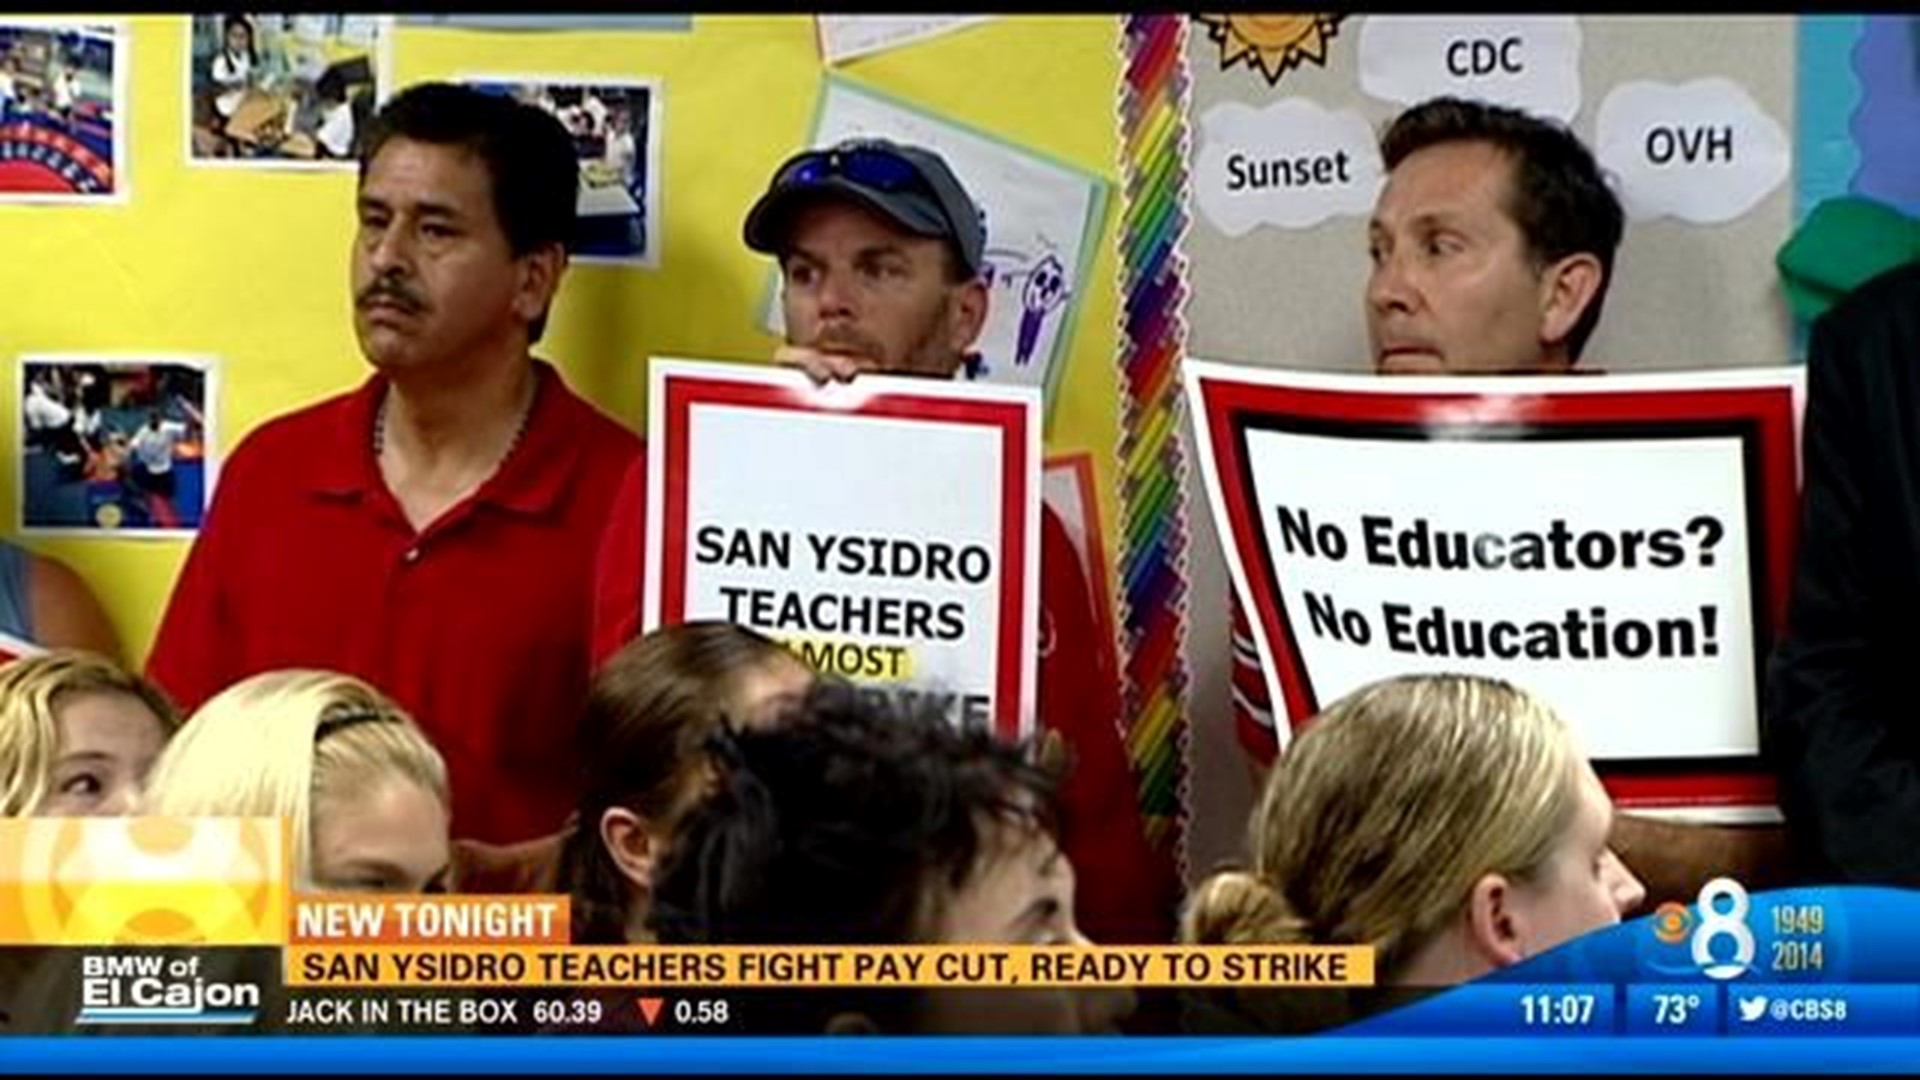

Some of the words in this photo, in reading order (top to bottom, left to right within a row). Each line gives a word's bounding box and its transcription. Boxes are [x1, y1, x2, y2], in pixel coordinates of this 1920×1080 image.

[1446, 37, 1524, 77] CDC
[1645, 126, 1733, 165] OVH
[1225, 149, 1350, 191] Sunset
[695, 526, 791, 570] SAN
[806, 533, 992, 584] YSIDRO
[1276, 505, 1347, 561] No
[1361, 515, 1725, 571] Educators?
[719, 586, 966, 640] TEACHERS
[1303, 591, 1371, 646] No
[1382, 604, 1719, 660] Education!
[778, 642, 905, 677] MOST
